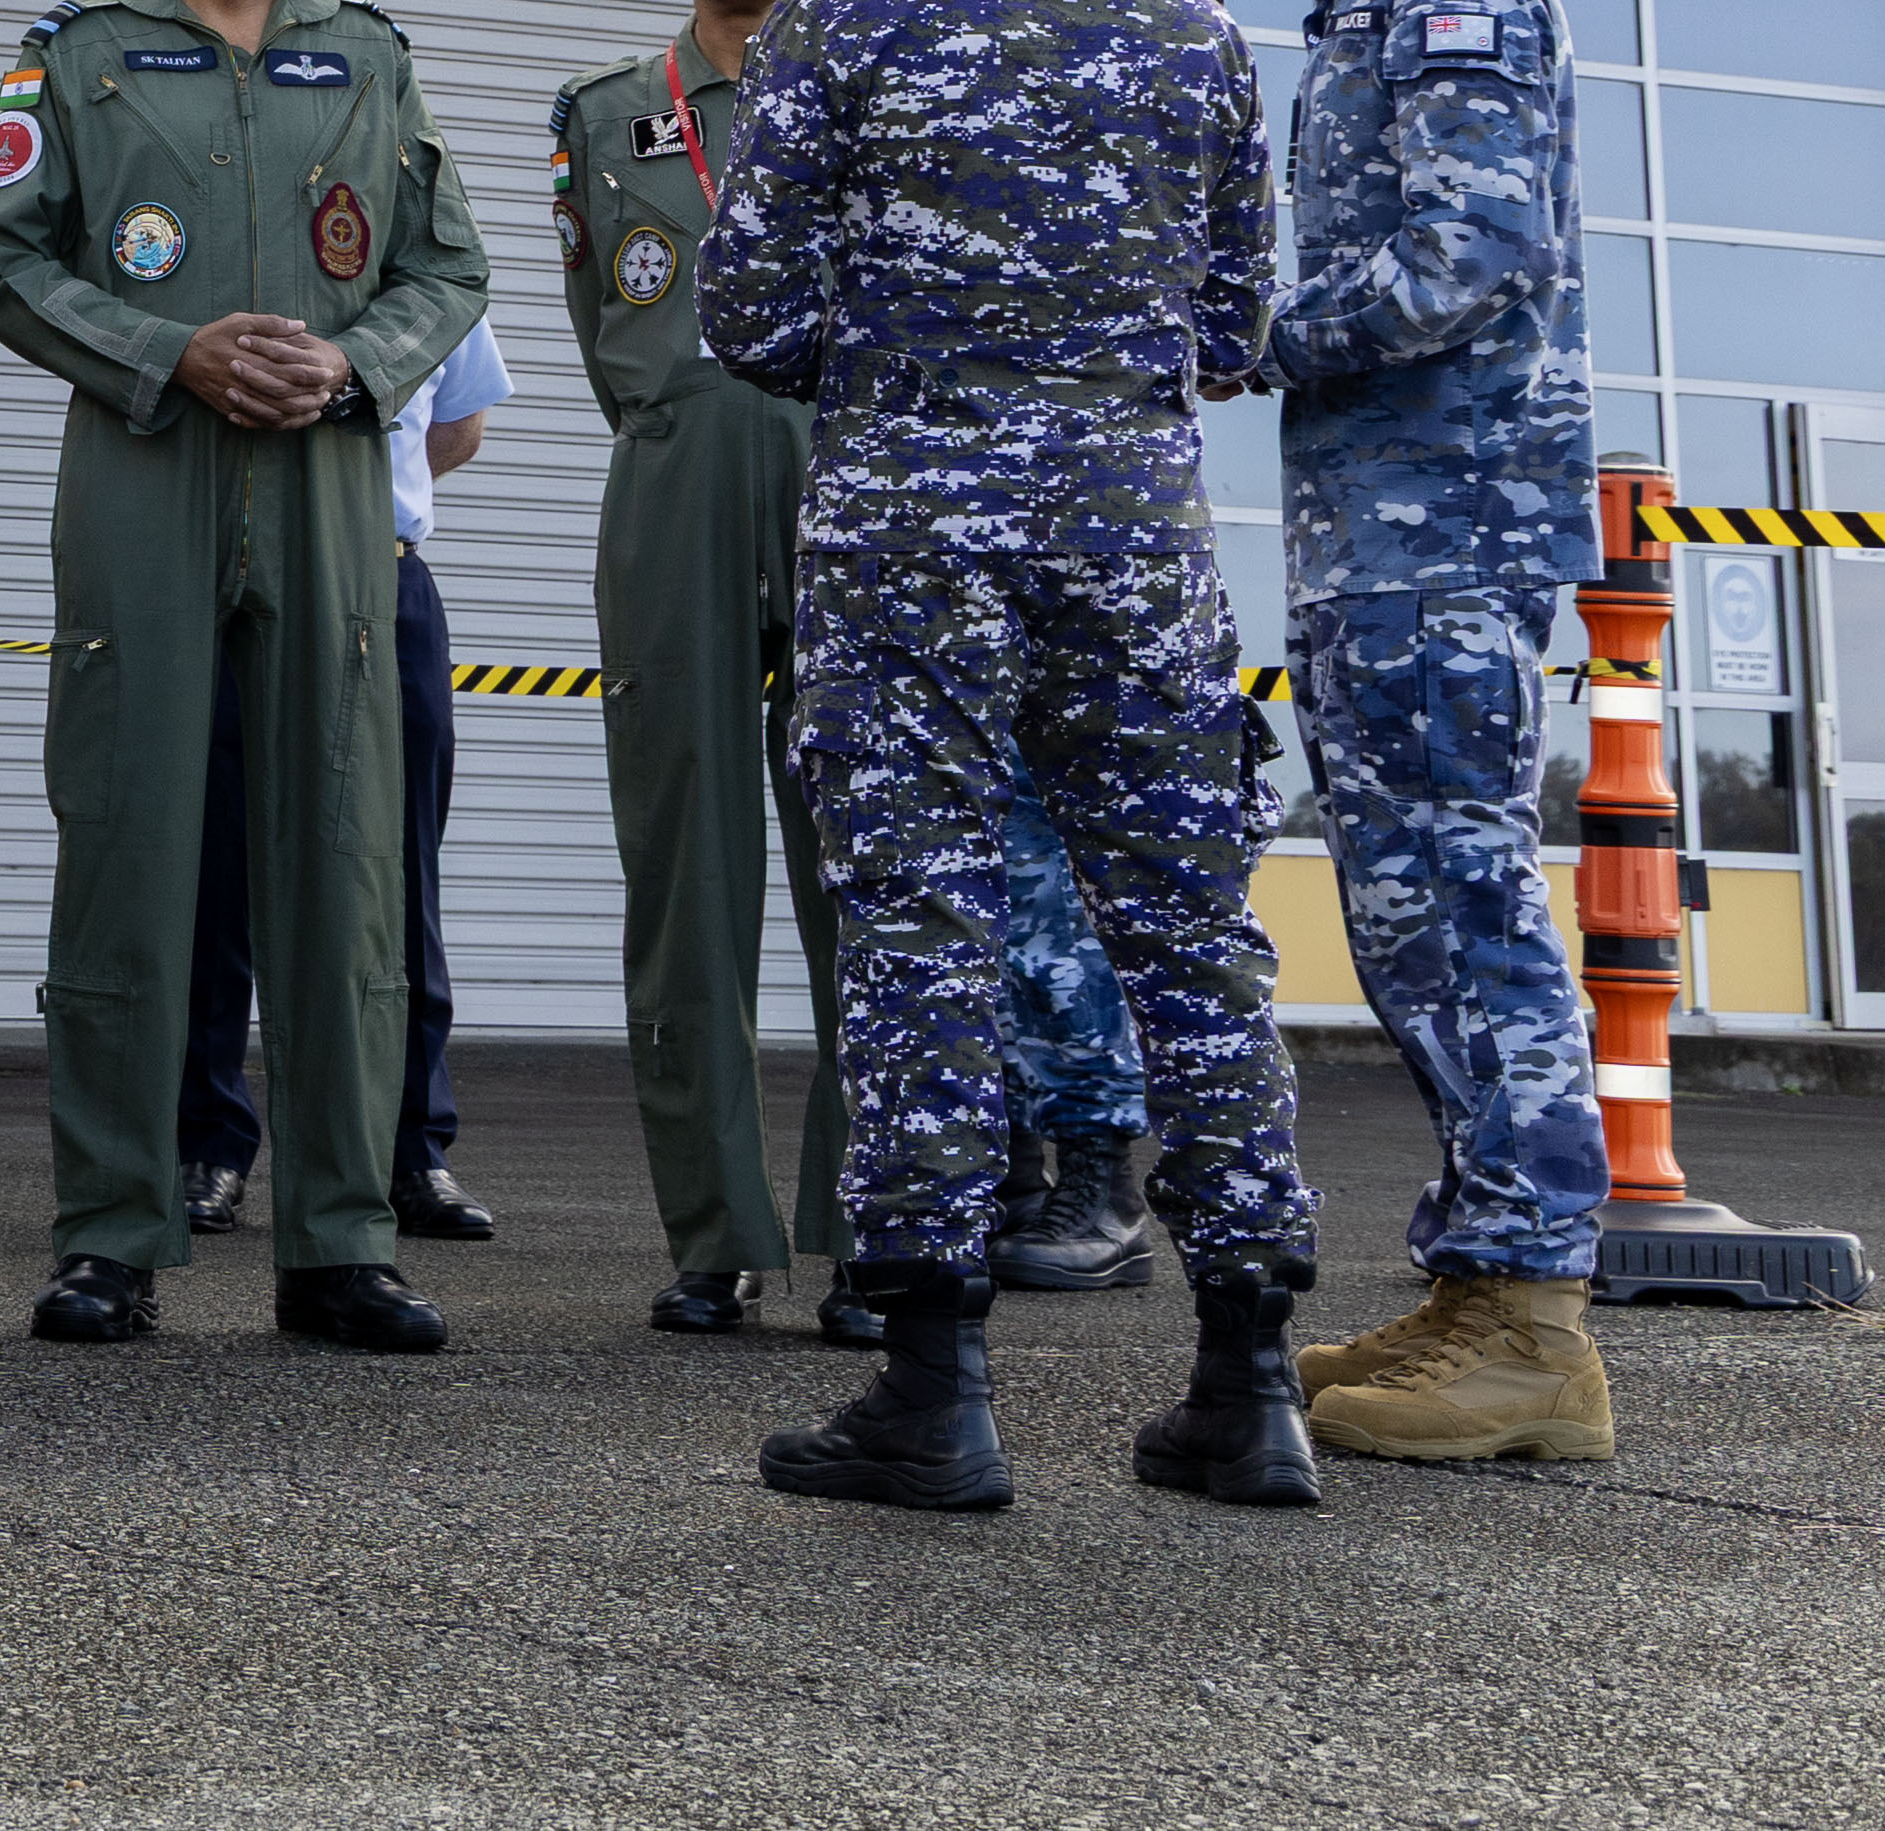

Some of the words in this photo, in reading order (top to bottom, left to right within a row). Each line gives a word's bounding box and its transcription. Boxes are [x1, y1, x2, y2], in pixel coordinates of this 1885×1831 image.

[140, 56, 155, 64] SK
[155, 56, 201, 66] TALIYAN
[674, 96, 691, 132] VISITOR
